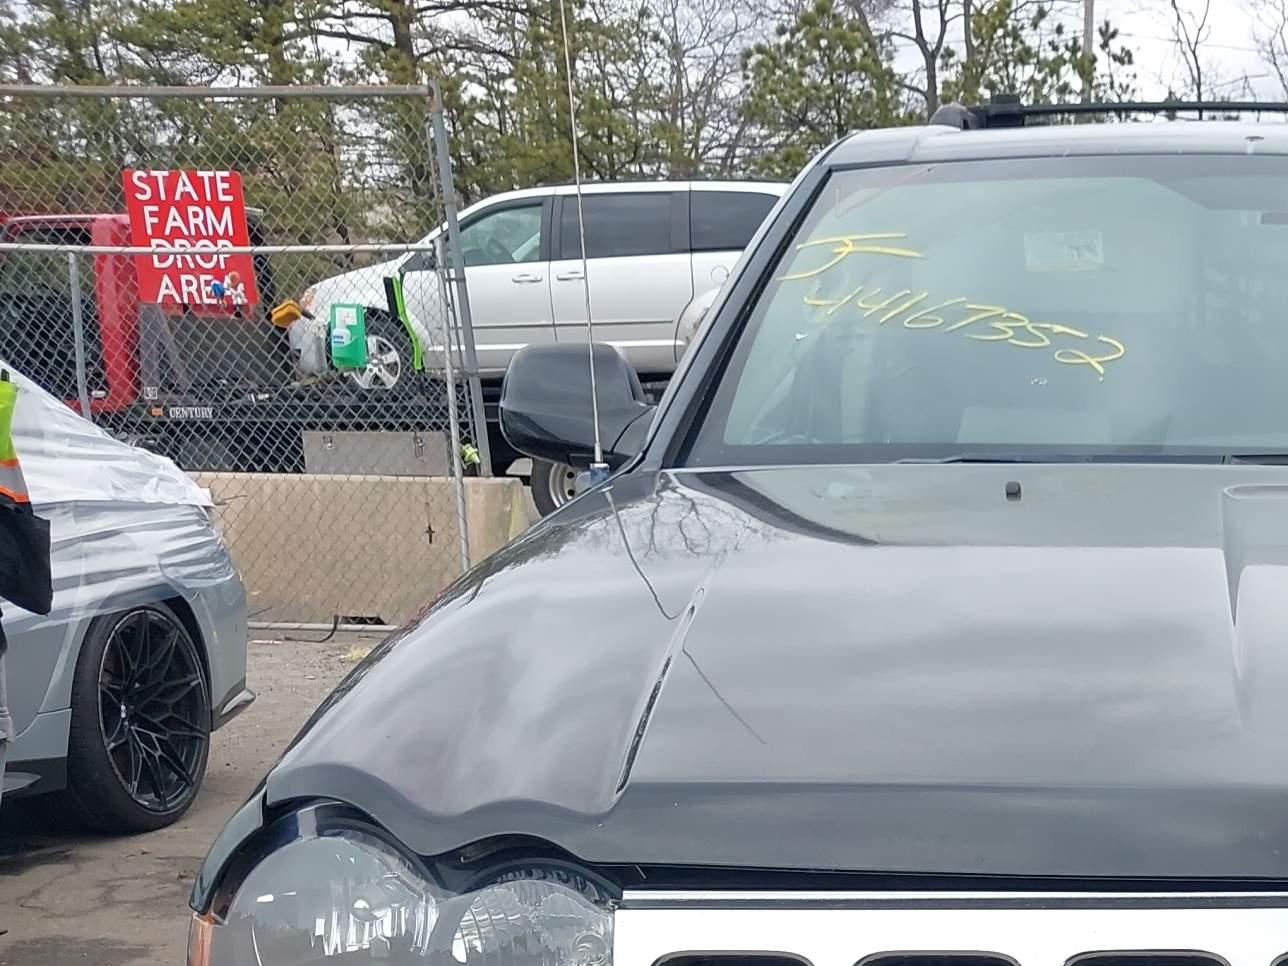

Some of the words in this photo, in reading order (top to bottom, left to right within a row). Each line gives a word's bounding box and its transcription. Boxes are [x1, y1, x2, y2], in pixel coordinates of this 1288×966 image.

[132, 170, 234, 202] STATE
[143, 205, 234, 236] FARM
[150, 238, 233, 270] DROP
[803, 280, 1125, 375] 44167352
[169, 406, 213, 419] CENTURY
